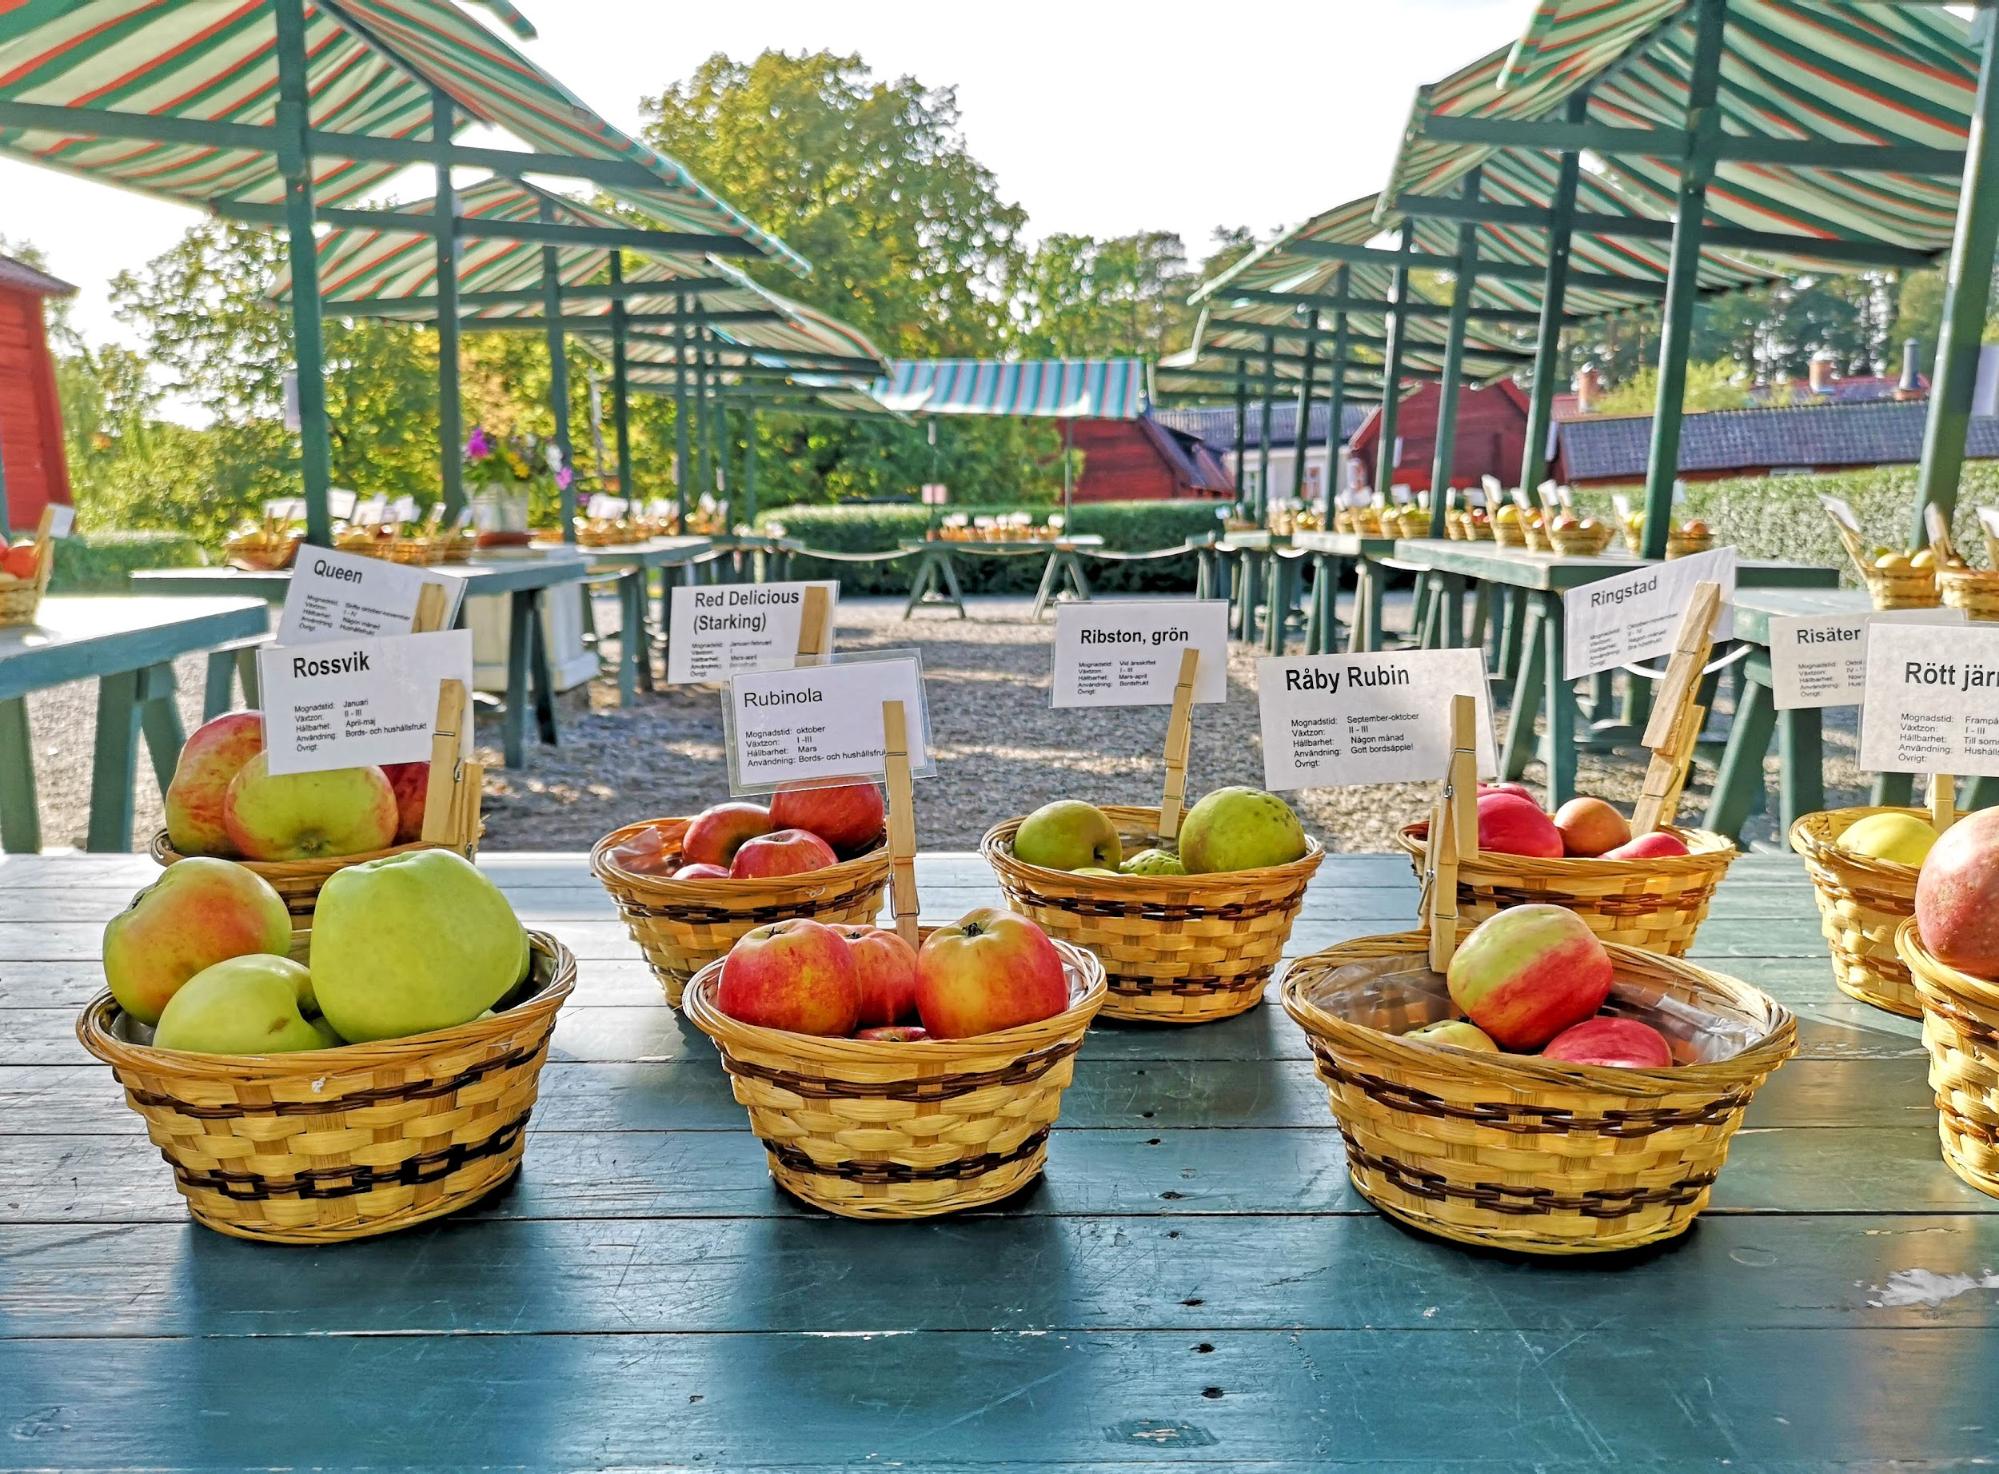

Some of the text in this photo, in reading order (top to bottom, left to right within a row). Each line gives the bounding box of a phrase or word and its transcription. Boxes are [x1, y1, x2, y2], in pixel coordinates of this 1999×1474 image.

[313, 559, 363, 584] Queen
[695, 589, 799, 608] Red Delicious
[1591, 575, 1657, 608] Ringstad
[693, 612, 767, 634] (Starking)
[1081, 627, 1189, 645] Ribston, grön
[1796, 627, 1861, 644] Risäter
[293, 651, 370, 678] Rossvik
[1286, 665, 1410, 694] Råby Rubin
[1905, 662, 1956, 685] Rött
[744, 688, 823, 708] Rubinola
[295, 699, 369, 713] Mognadstid: Januari
[345, 719, 376, 728] April-maj
[1291, 712, 1419, 728] Mognadstid: September-oktober
[1901, 713, 1954, 723] Mognadstid:
[345, 728, 368, 737] Bords-
[369, 727, 383, 735] och
[384, 722, 427, 733] hushållsfrukt
[745, 725, 825, 739] Mognadstid: oktober
[1292, 728, 1325, 737] Växtzon:
[1900, 724, 1937, 732] Växtzon:
[746, 739, 780, 747] Växtzon:
[1293, 733, 1405, 747] Hållbarhet: Någon månad
[1900, 734, 1947, 743] Hållbarhet:
[747, 747, 789, 757] Hållbarhet:
[1294, 748, 1342, 759] Användning:
[1351, 746, 1368, 754] Gott
[1898, 744, 1952, 754] Användning:
[748, 756, 796, 767] Användning:
[798, 754, 825, 763] Bords-
[1295, 758, 1320, 769] Övrigt:
[1898, 753, 1927, 763] Övrigt:
